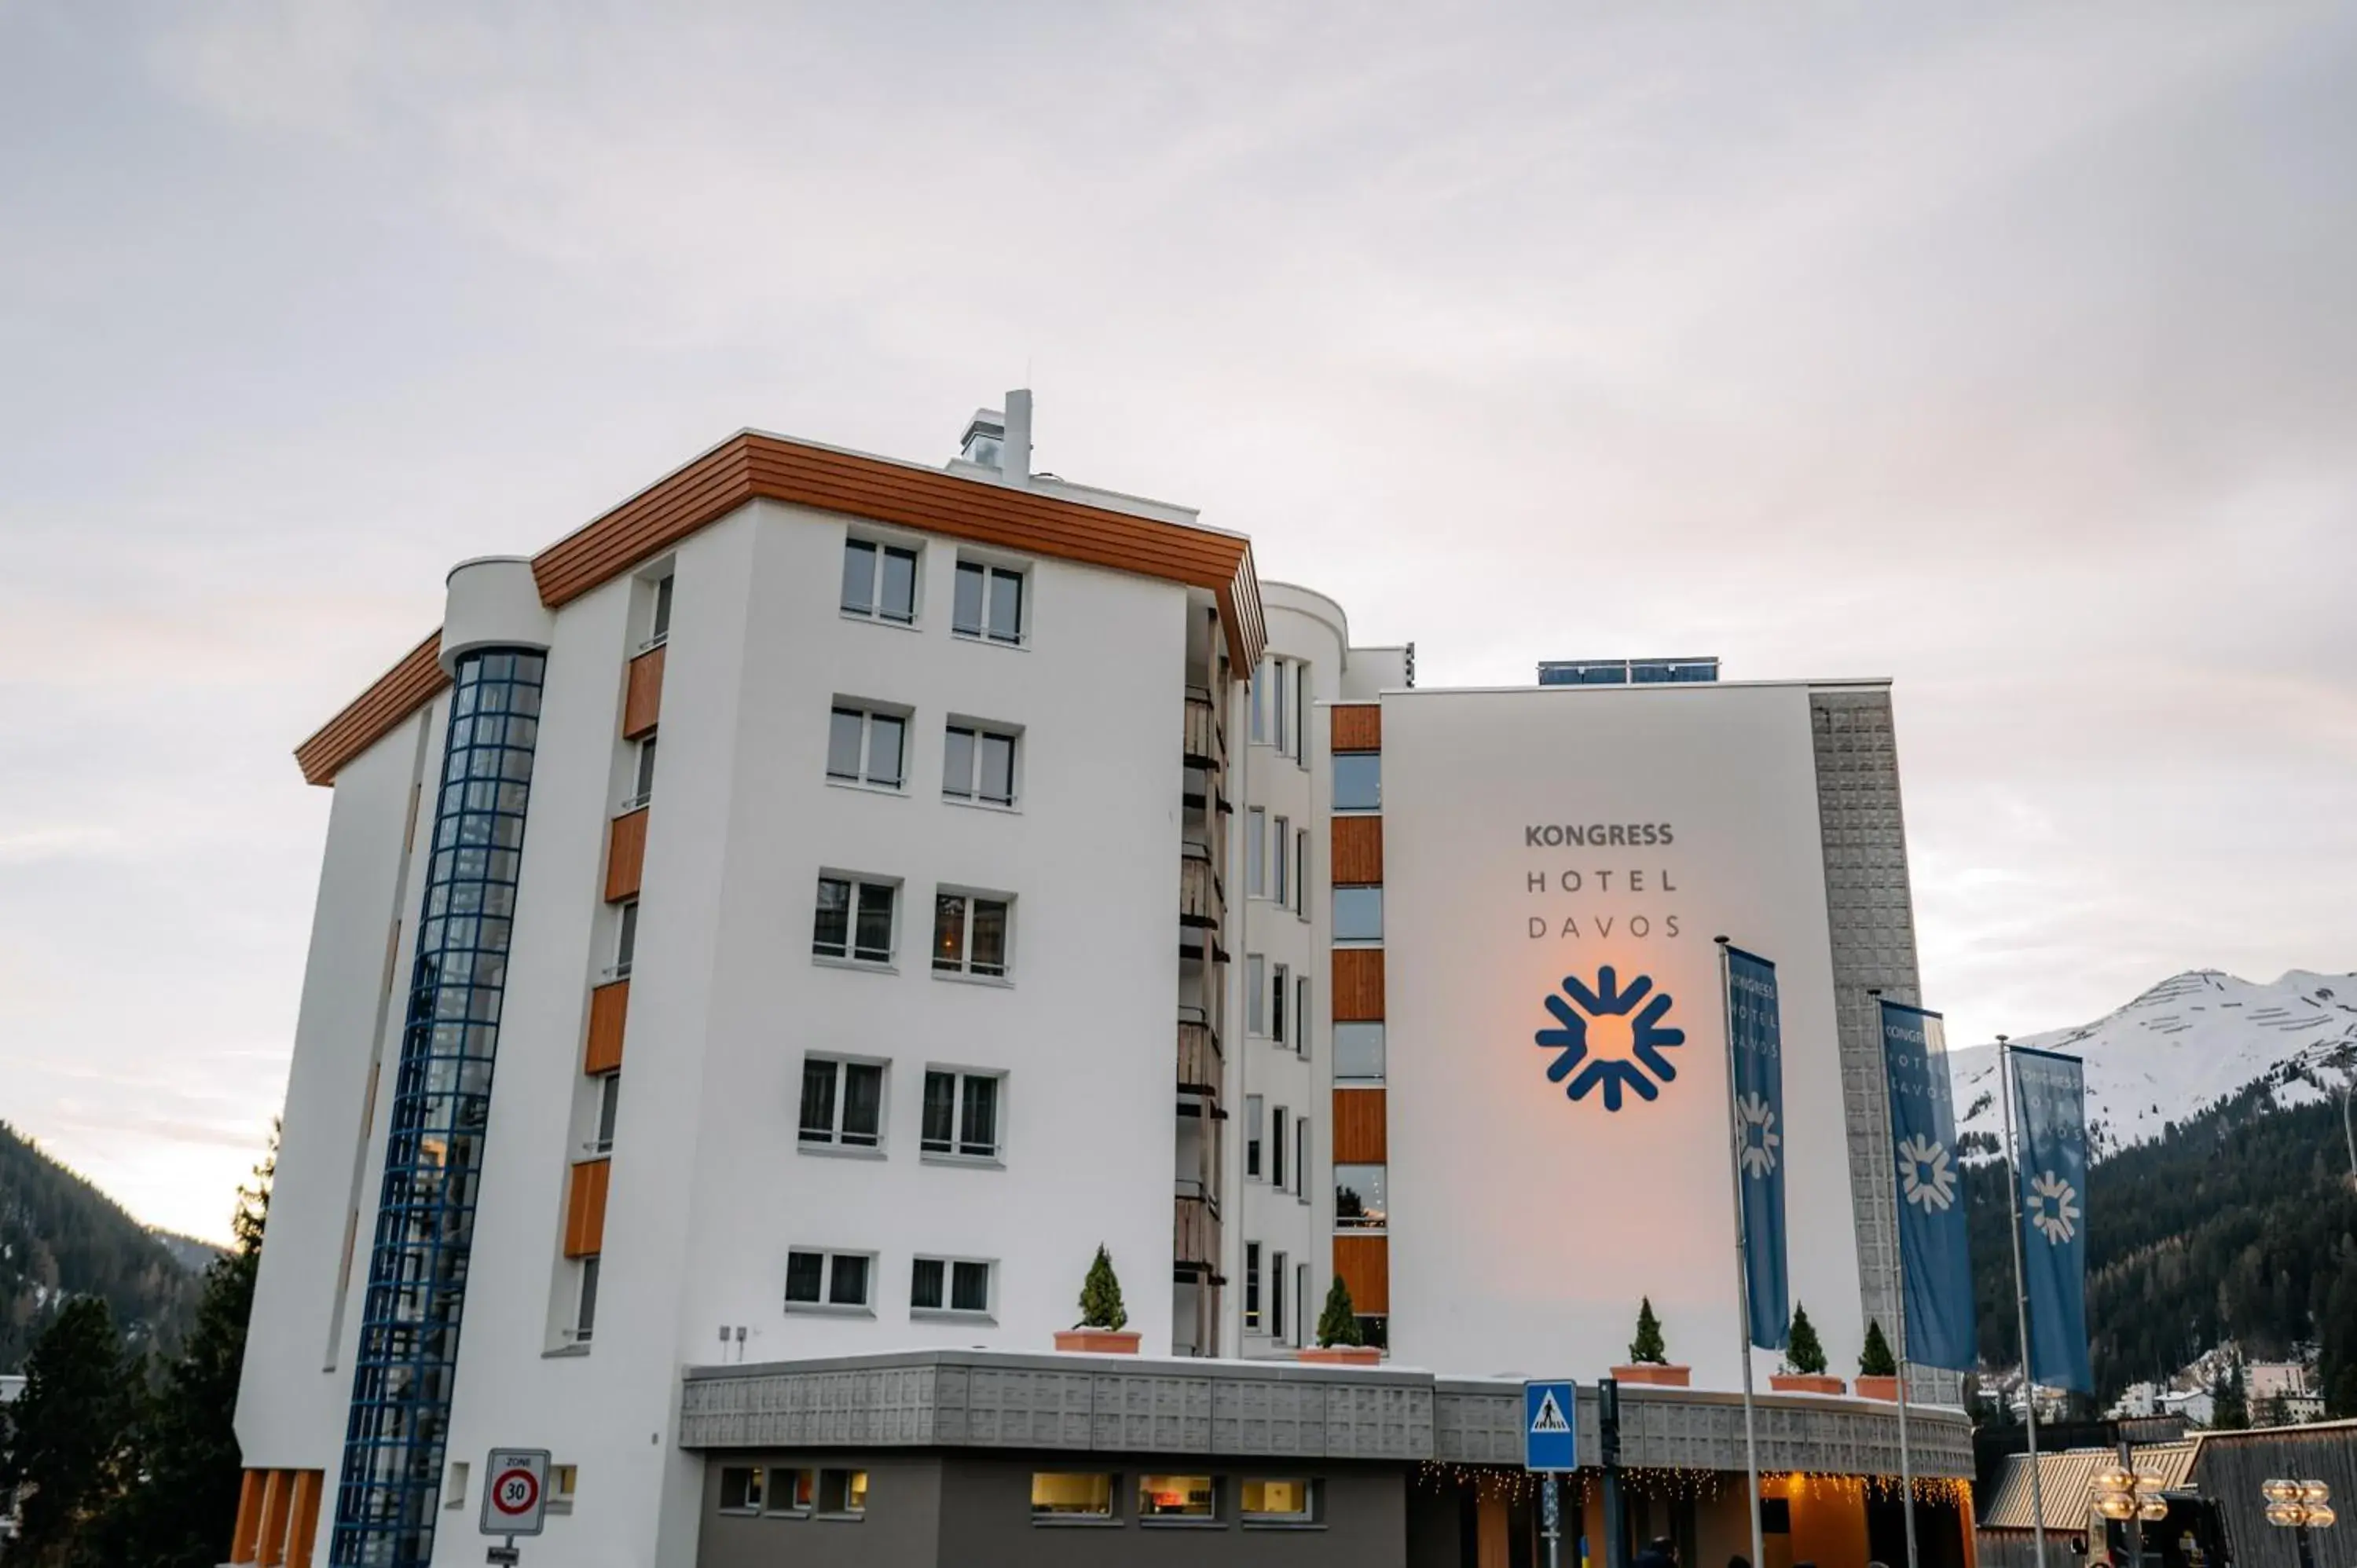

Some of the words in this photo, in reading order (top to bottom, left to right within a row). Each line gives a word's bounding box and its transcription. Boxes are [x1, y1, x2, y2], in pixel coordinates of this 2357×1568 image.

[1525, 823, 1674, 847] KONGRESS
[1527, 869, 1677, 893] HOTEL
[1528, 915, 1680, 939] DAVOS
[506, 1457, 531, 1467] ZONE
[506, 1483, 525, 1500] 30
